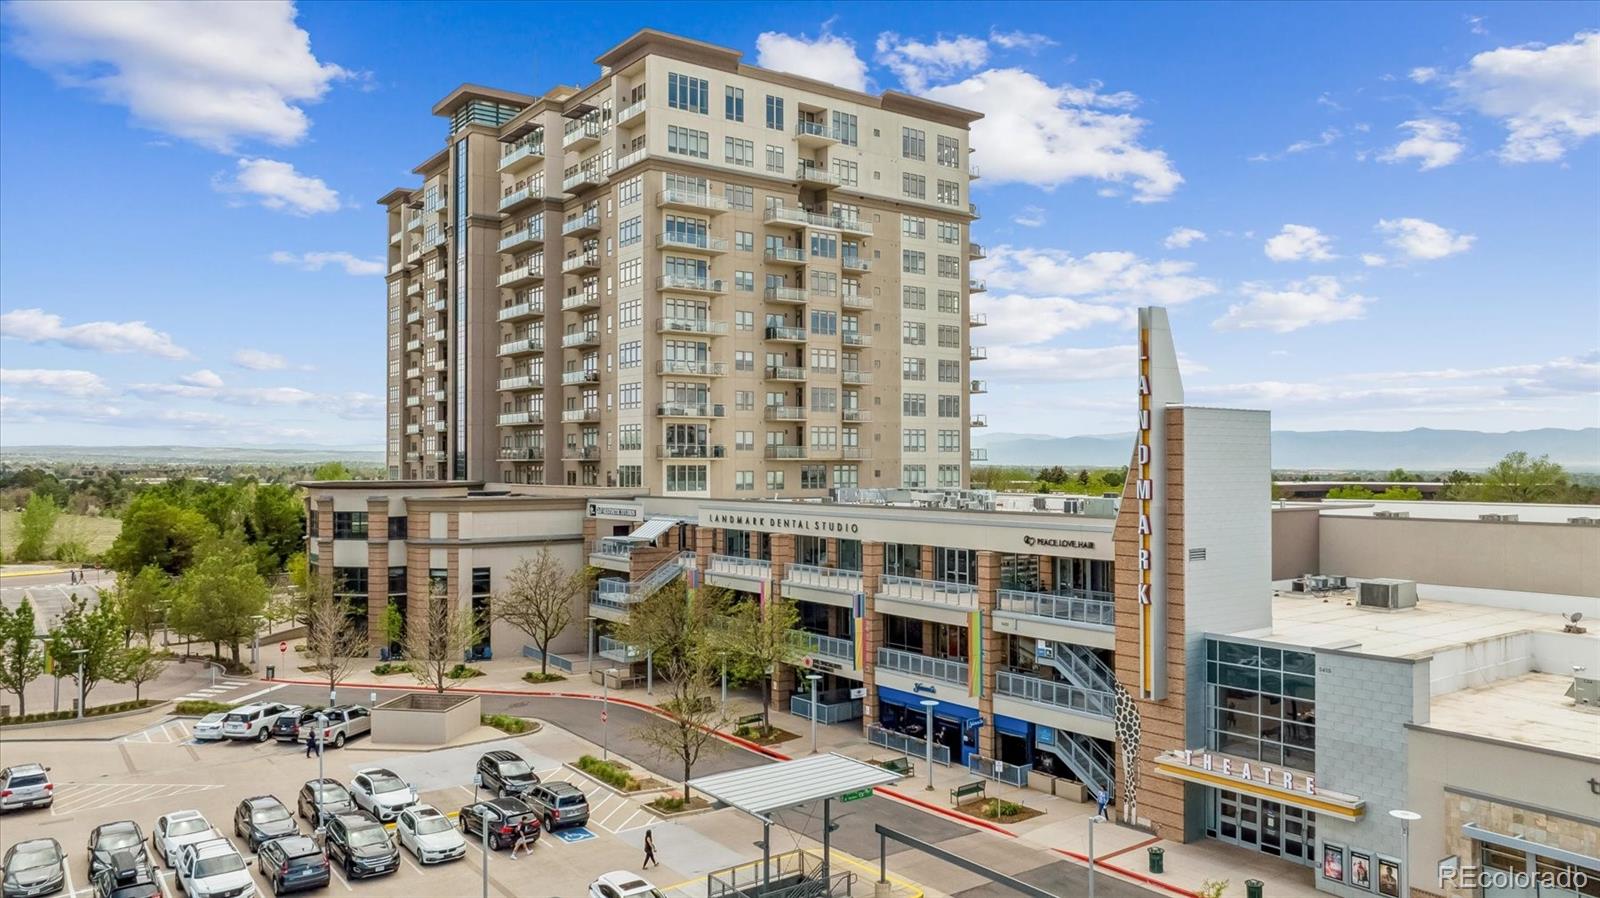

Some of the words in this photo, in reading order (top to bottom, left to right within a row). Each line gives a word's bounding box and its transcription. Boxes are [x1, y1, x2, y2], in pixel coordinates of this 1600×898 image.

[709, 514, 765, 527] LANDMARK
[769, 518, 810, 530] DENTAL
[814, 521, 859, 534] STUDIO
[1184, 749, 1316, 796] THEATRE
